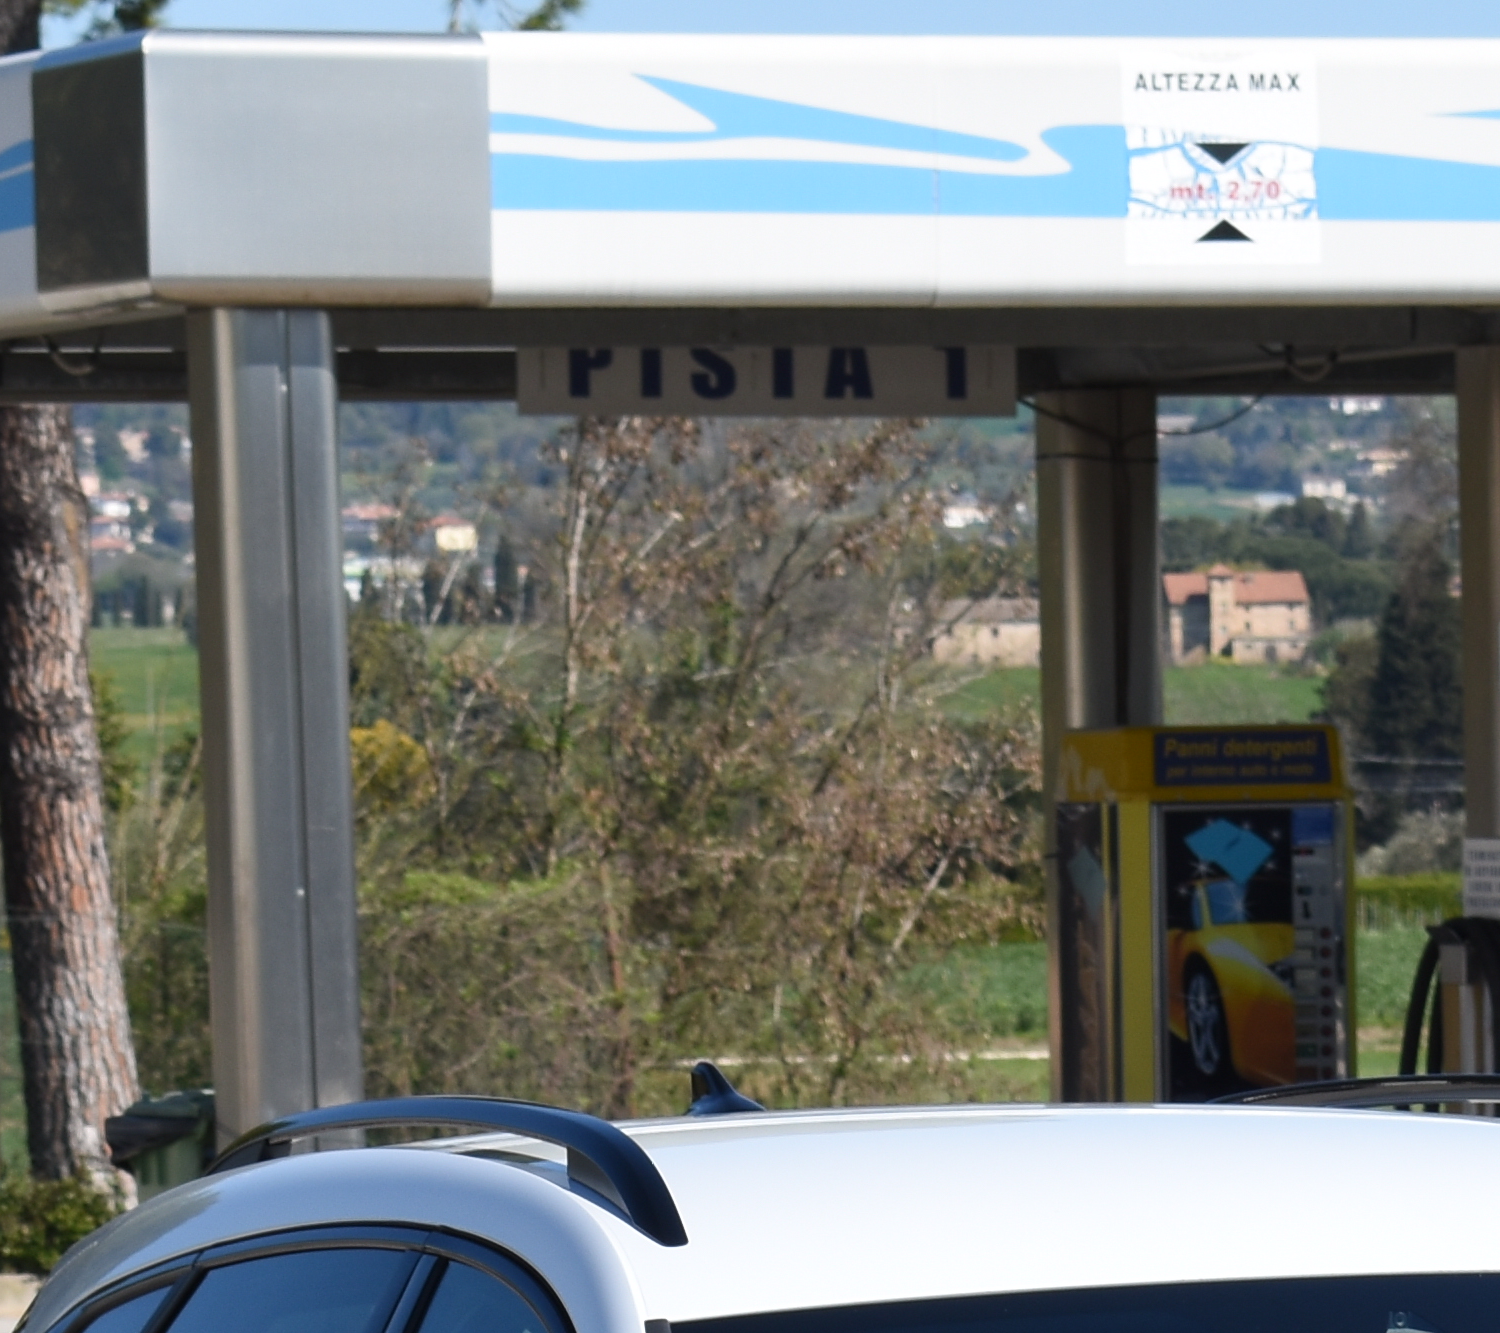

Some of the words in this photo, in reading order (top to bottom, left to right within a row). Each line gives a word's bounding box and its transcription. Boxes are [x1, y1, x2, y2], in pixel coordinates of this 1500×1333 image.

[1135, 72, 1239, 92] ALTEZZA
[1249, 72, 1301, 92] MAX
[1170, 182, 1214, 200] mt.
[1228, 180, 1281, 202] 2,70
[1164, 737, 1218, 758] Panni
[1223, 736, 1318, 762] detergenti
